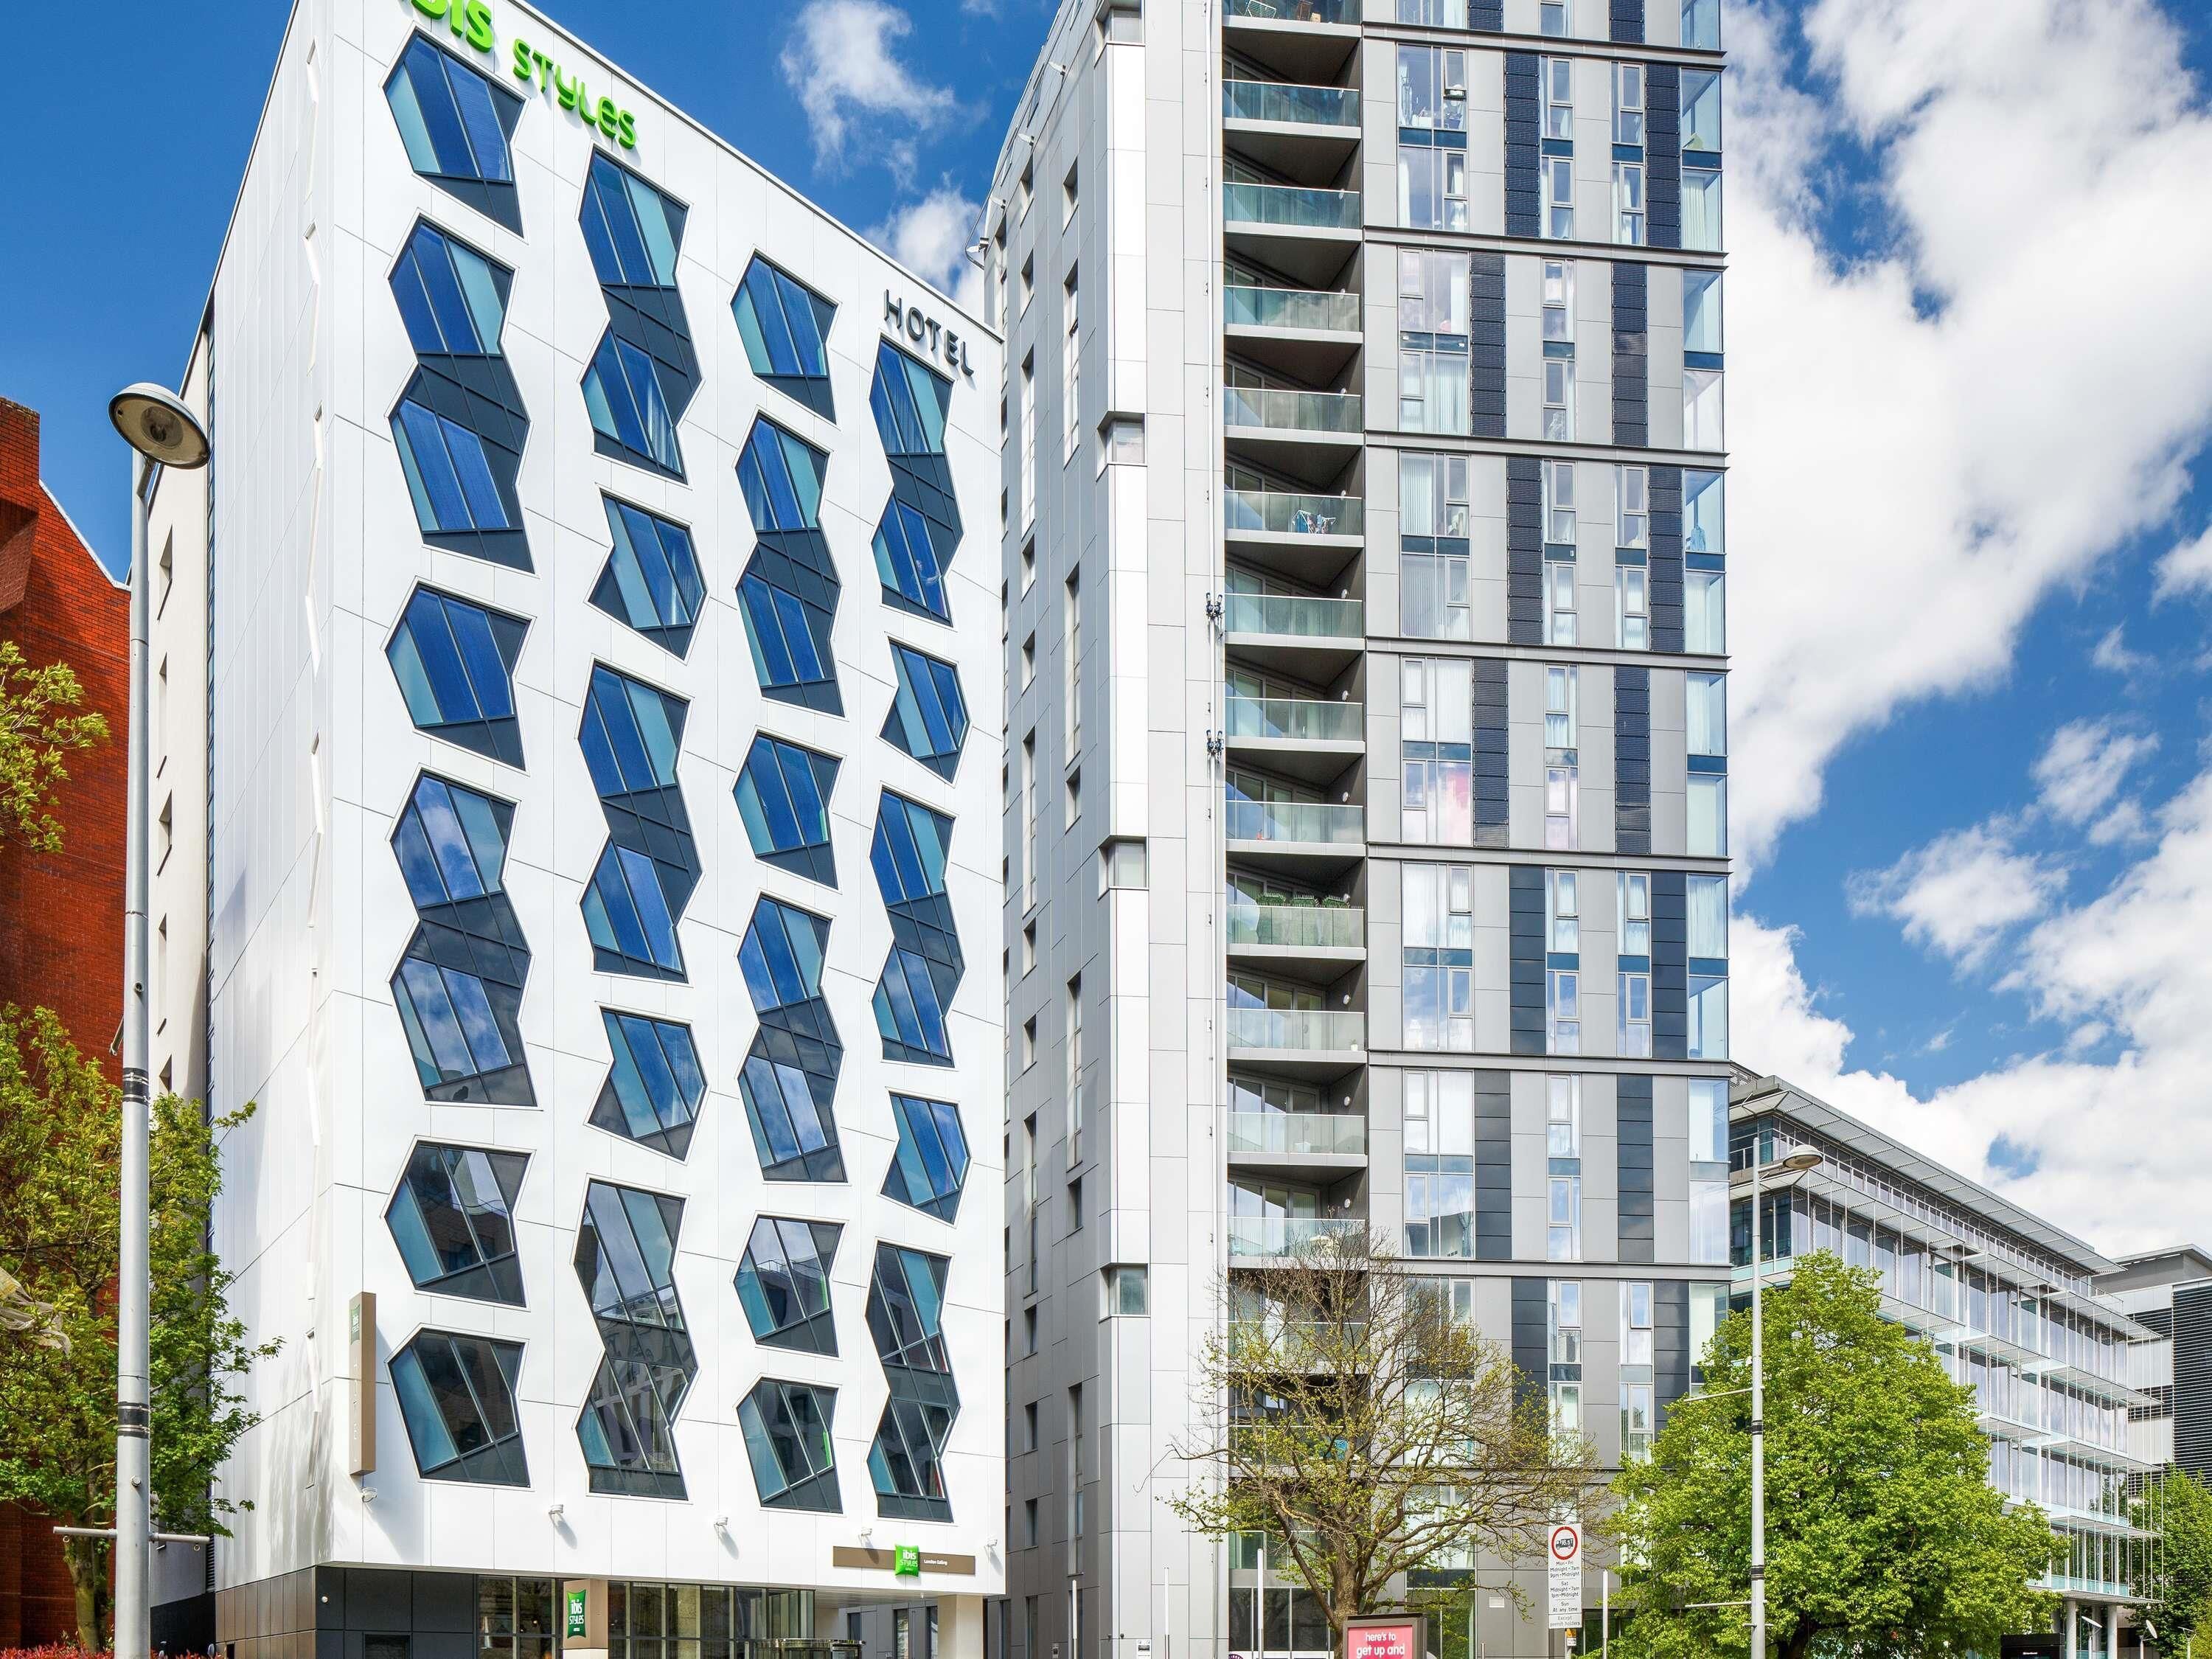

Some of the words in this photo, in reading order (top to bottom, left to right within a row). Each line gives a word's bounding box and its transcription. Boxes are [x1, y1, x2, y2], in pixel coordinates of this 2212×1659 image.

[884, 289, 974, 377] HOTEL
[902, 1549, 917, 1559] ibis
[571, 1599, 582, 1614] ibis
[1366, 1632, 1387, 1641] here's
[1388, 1632, 1396, 1641] to
[1356, 1644, 1372, 1658] get
[1374, 1646, 1385, 1658] up
[1388, 1644, 1405, 1655] and
